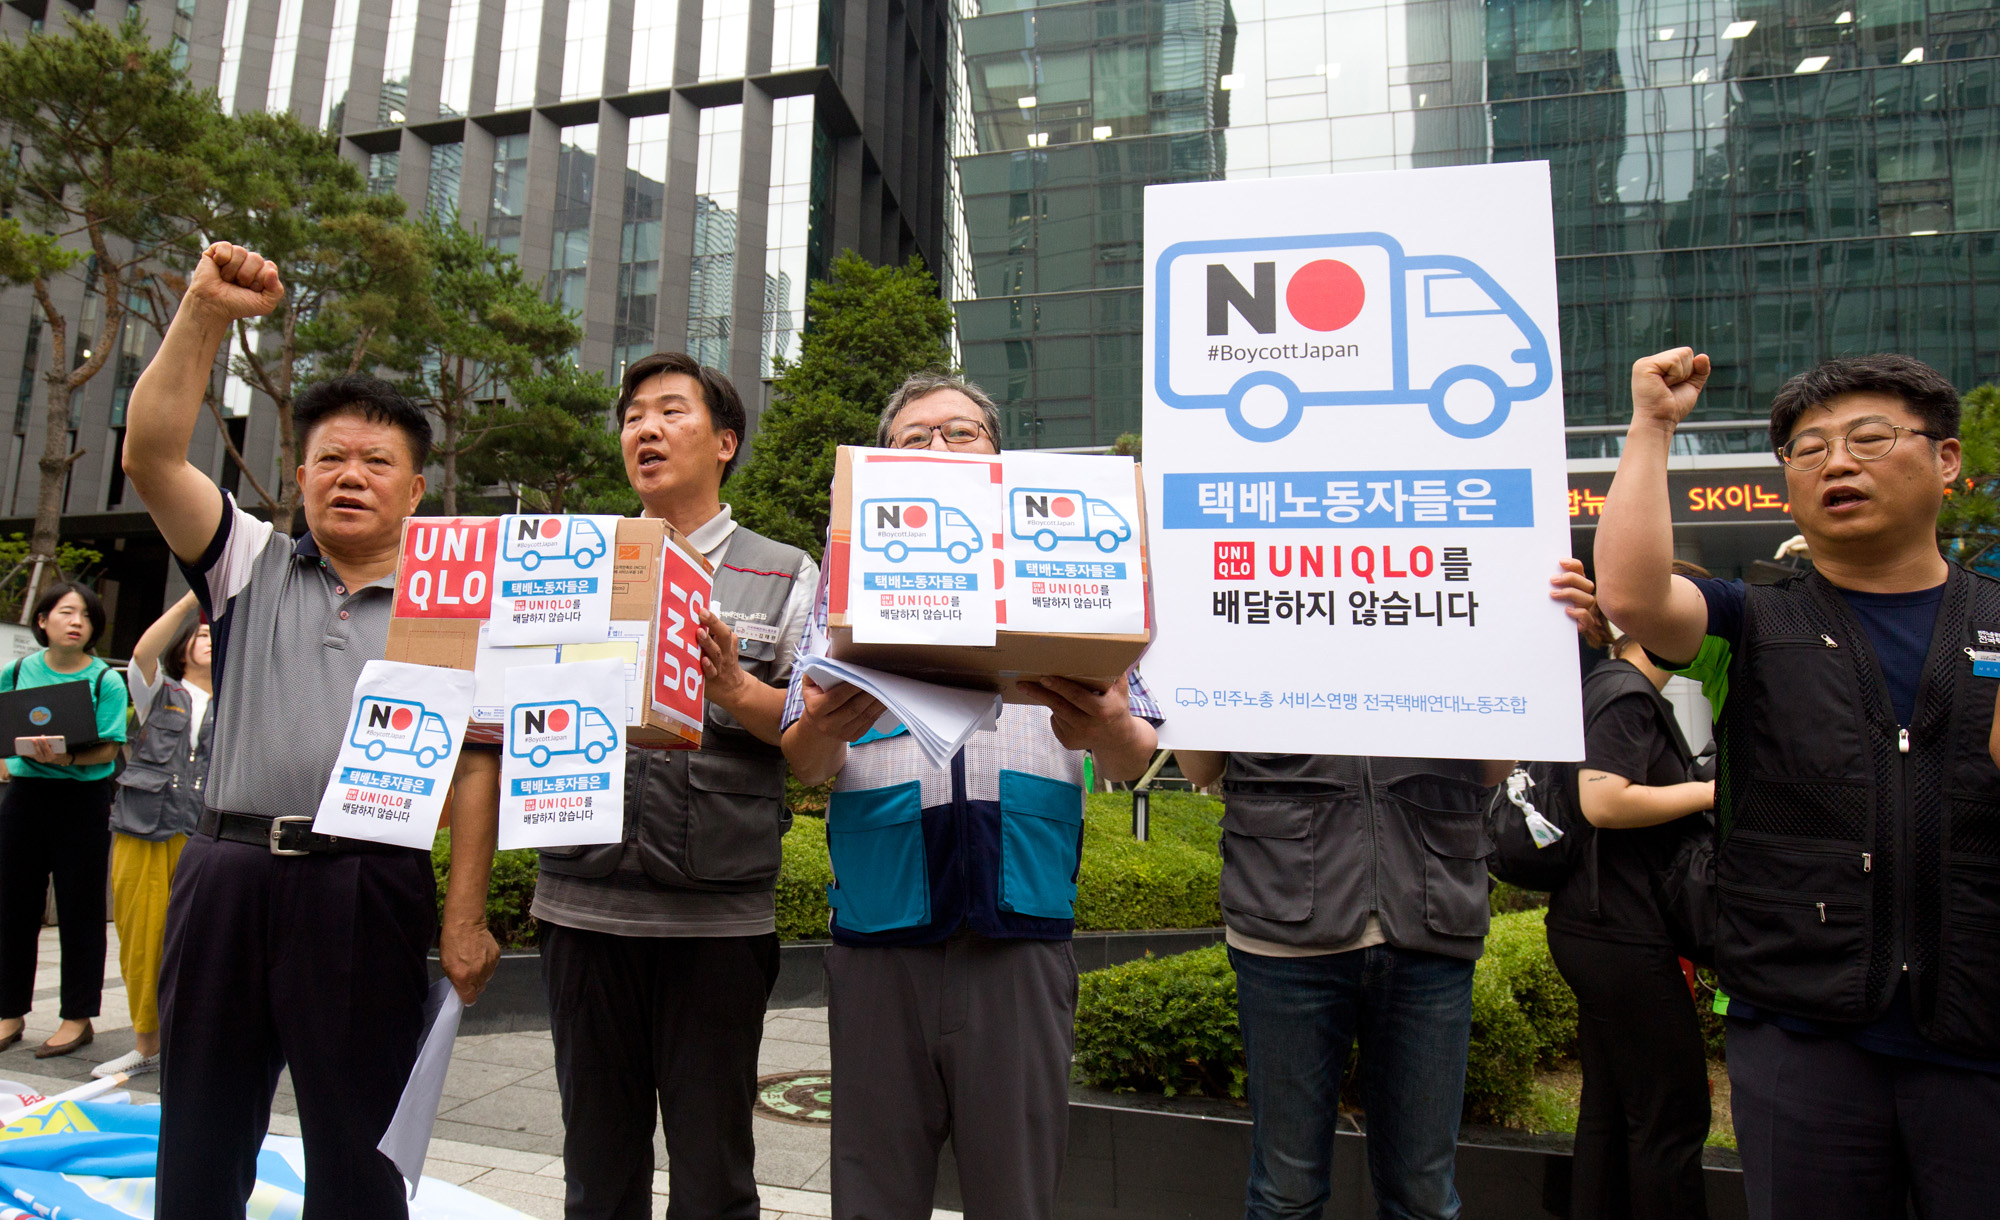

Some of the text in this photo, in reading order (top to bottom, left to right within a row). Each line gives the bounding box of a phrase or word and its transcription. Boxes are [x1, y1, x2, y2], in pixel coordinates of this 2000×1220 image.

[1208, 343, 1359, 363] #BoycottJapan
[1199, 478, 1496, 523] 택배노동자들은
[415, 528, 486, 562] UNI
[1219, 546, 1248, 560] UNI
[1026, 563, 1116, 578] 택배노동자들은
[1219, 562, 1250, 577] QLO
[512, 580, 589, 595] 택배노동자들은
[875, 575, 967, 589] 택배노동자들은
[408, 570, 486, 610] QLO
[1033, 597, 1112, 609] 배달하지 않습니다
[1213, 590, 1478, 626] 배달하지 않습니다
[513, 612, 581, 623] 배달하지 않습니다
[881, 609, 962, 620] 배달하지 않습니다
[664, 582, 688, 691] UNI
[1213, 690, 1527, 714] 민주노총 서비스연맹 전국택배연대노동조합
[366, 730, 405, 739] #BoycottJapan
[525, 735, 567, 743] #BoycottJapan
[350, 771, 424, 793] 택배노동자들은
[521, 776, 600, 794] 택배노동자들은
[342, 803, 410, 822] 배달하지 않습니다
[524, 810, 593, 824] 배달하지 않습니다
